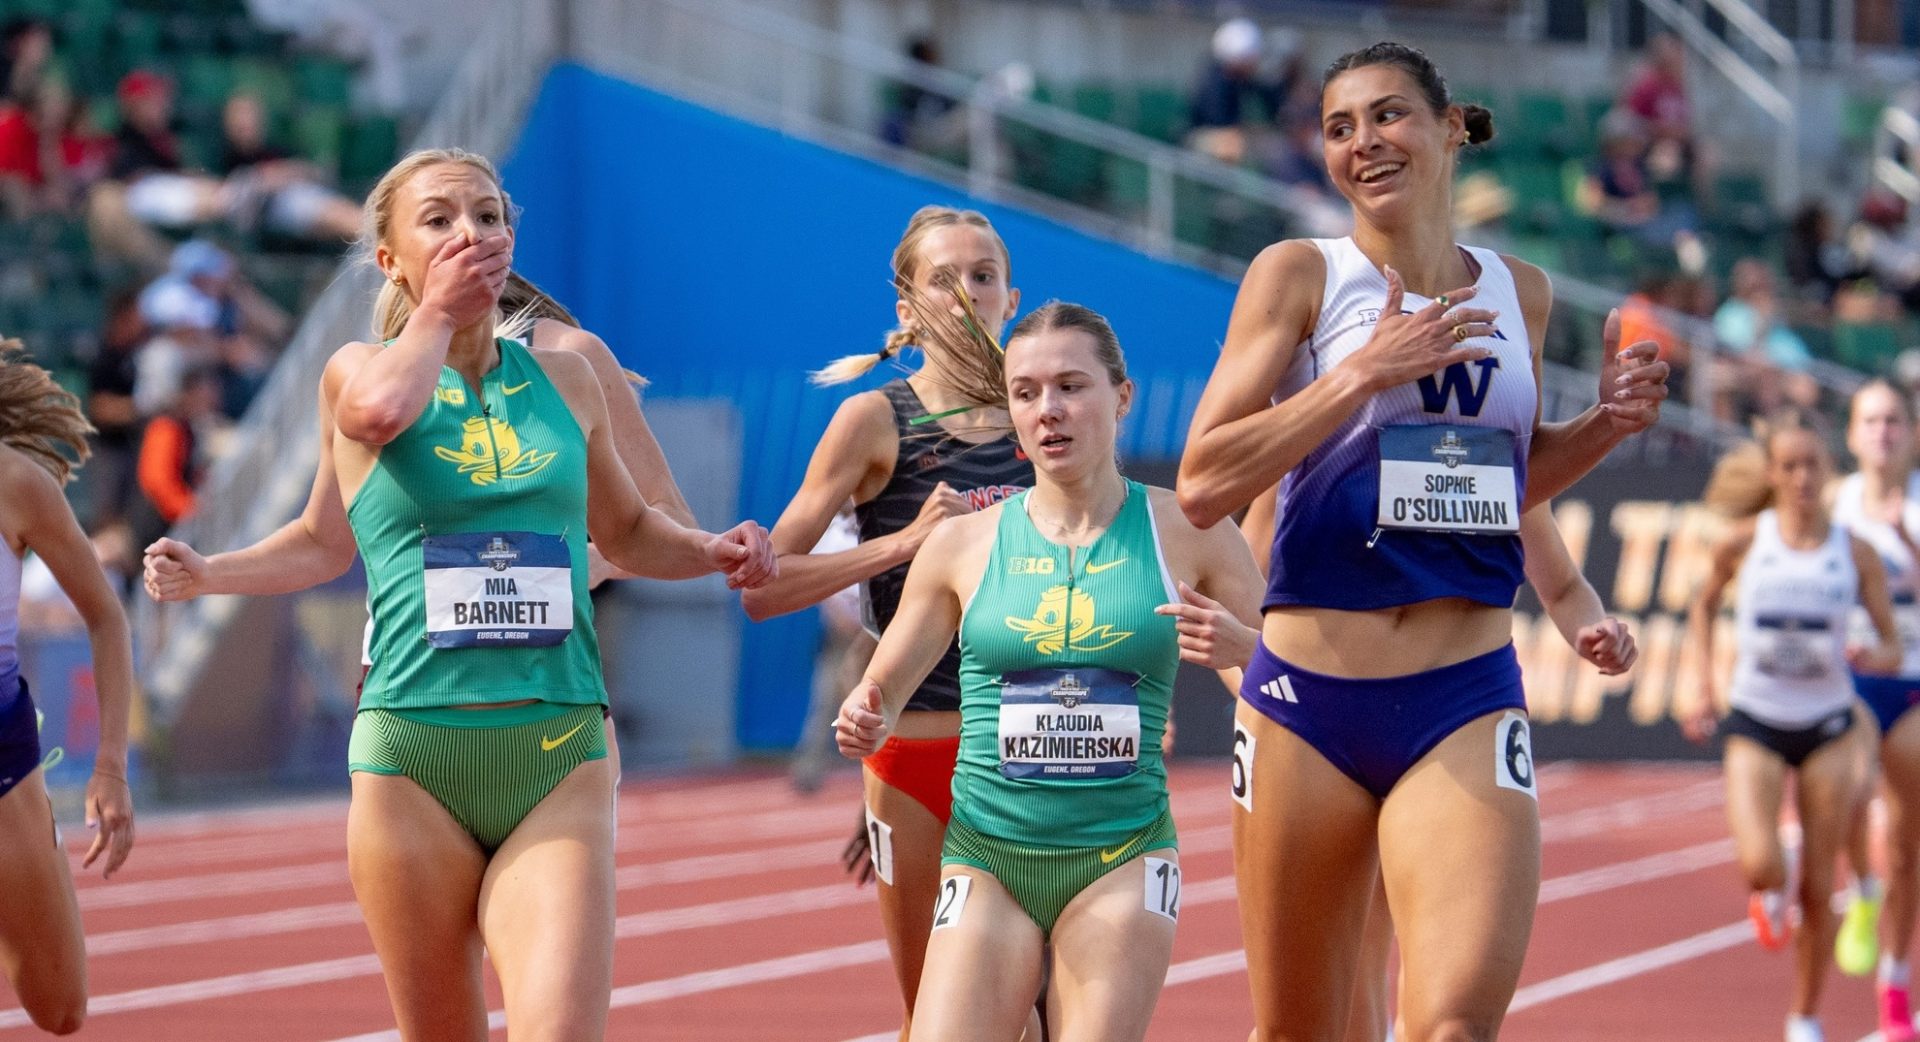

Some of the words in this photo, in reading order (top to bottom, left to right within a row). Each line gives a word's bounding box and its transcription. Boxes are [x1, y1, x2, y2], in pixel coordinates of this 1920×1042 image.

[1417, 357, 1500, 417] W
[1424, 474, 1477, 494] SOPHIE
[1393, 497, 1508, 525] O'SULLIVAN
[485, 578, 518, 596] MIA
[454, 601, 549, 625] BARNETT
[476, 631, 503, 640] EUGENE,
[504, 631, 530, 640] OREGON
[1036, 714, 1104, 732] KLAUDIA
[1004, 736, 1134, 759] KAZIMIERSKA
[1505, 719, 1533, 788] 6
[1043, 765, 1069, 773] EUGENE,
[1070, 765, 1096, 773] OREGON
[1232, 729, 1247, 798] 6
[1156, 862, 1179, 919] 12
